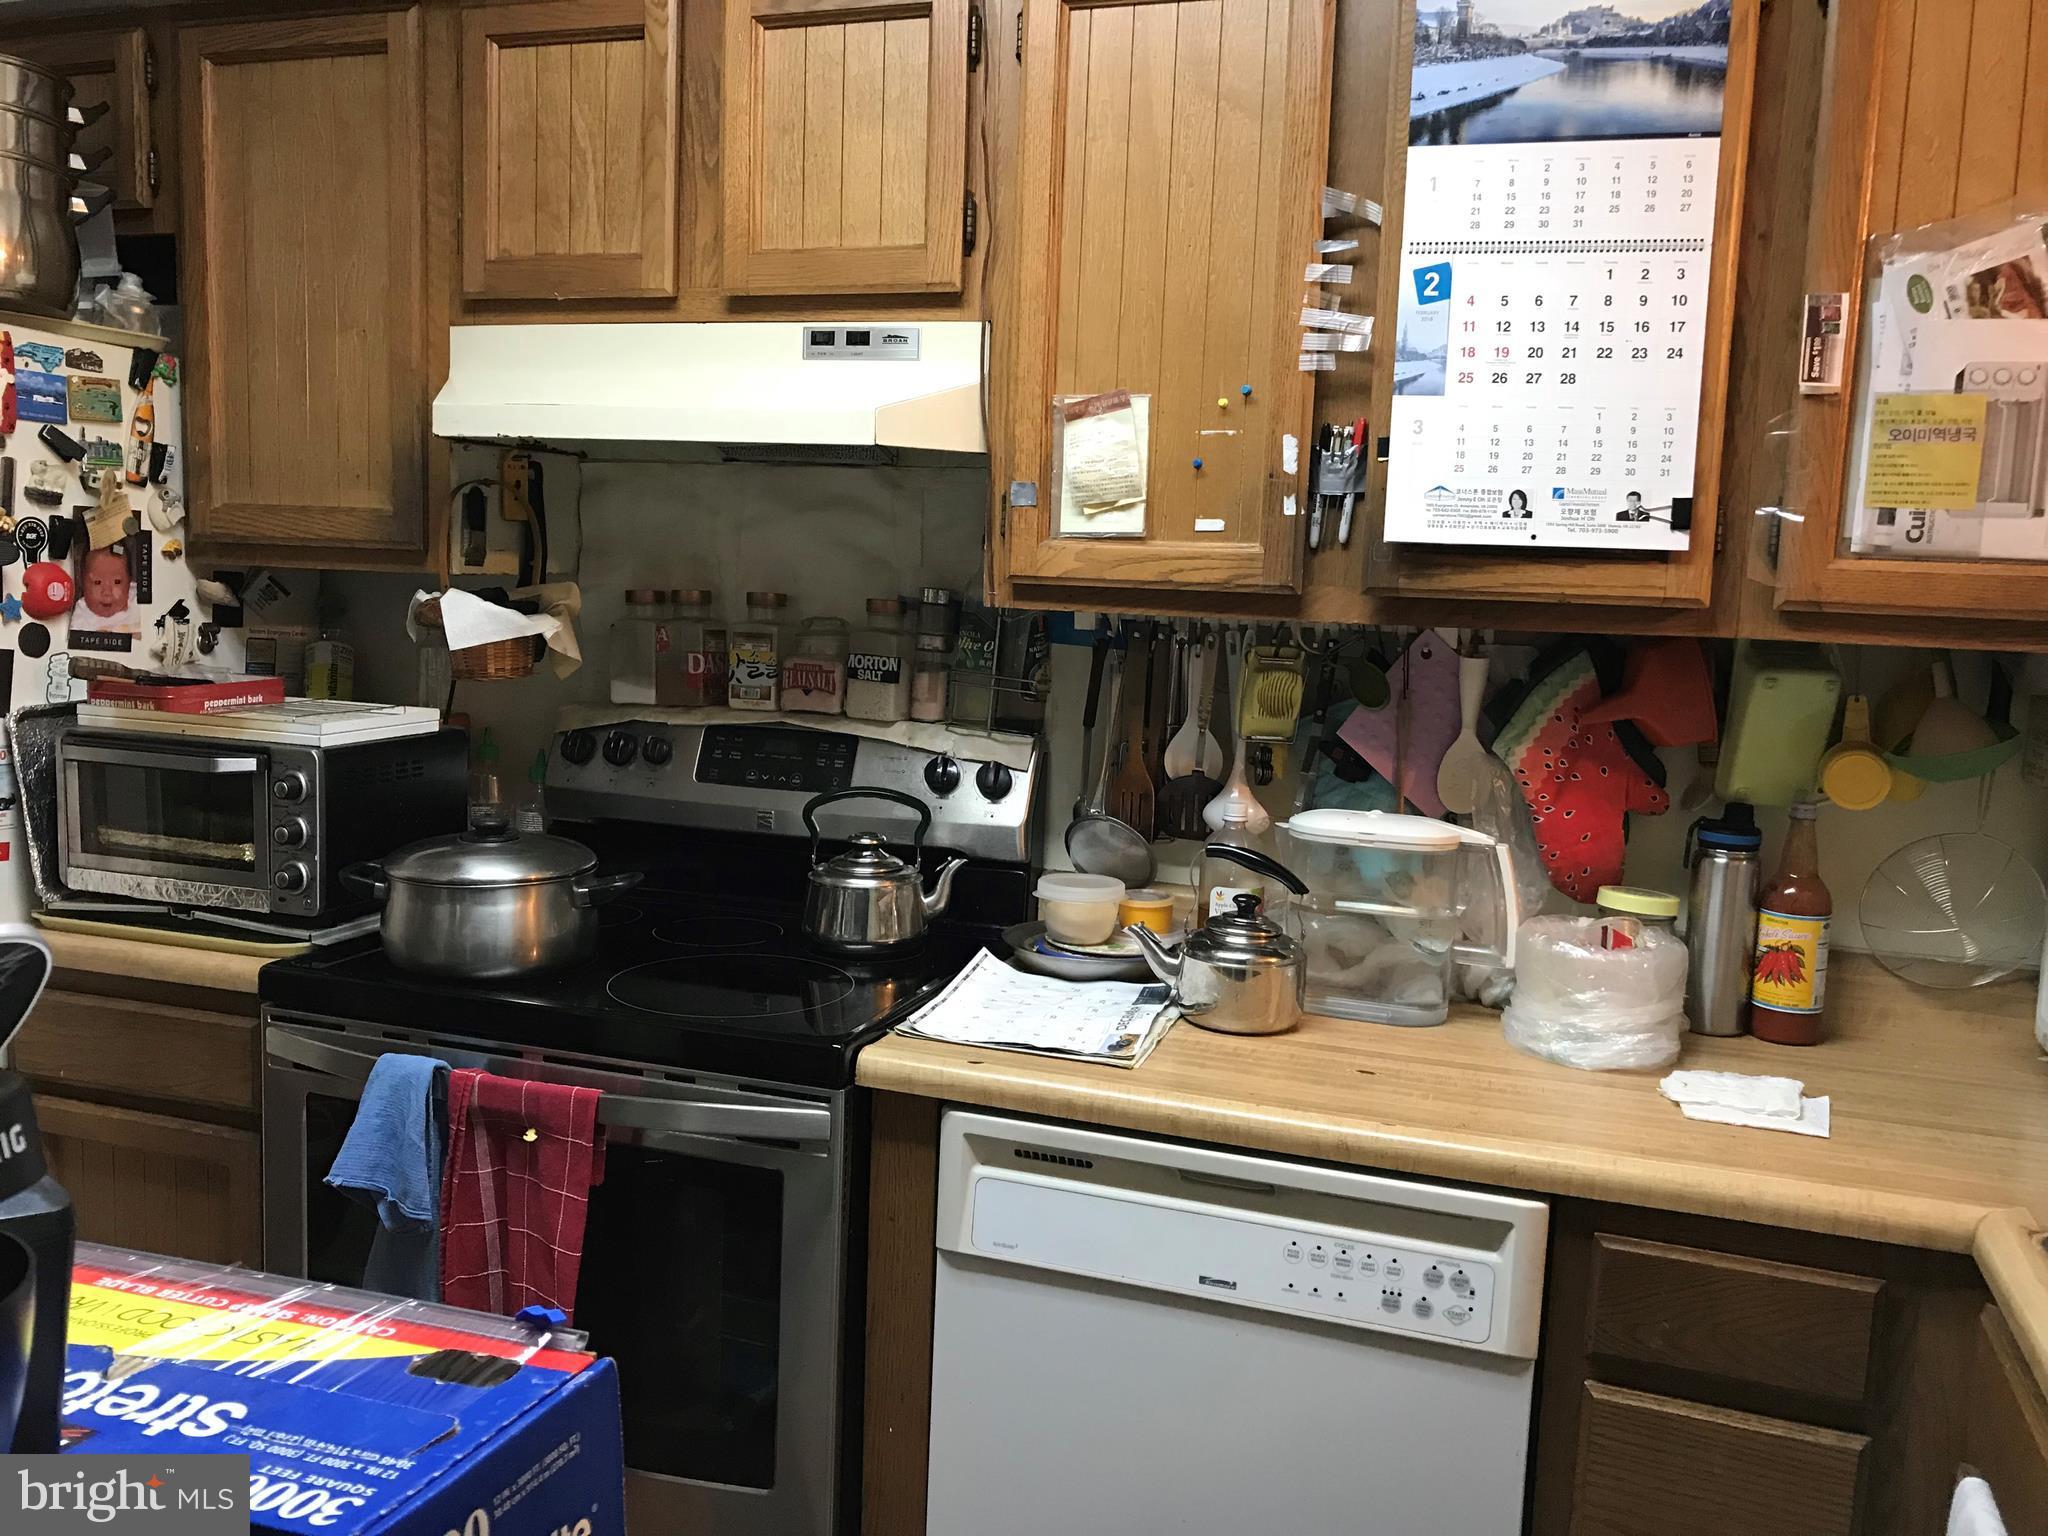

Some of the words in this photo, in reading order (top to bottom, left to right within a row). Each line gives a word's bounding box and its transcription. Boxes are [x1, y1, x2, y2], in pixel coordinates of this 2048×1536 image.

[1430, 176, 1438, 191] 1
[1474, 179, 1481, 188] 7
[1508, 178, 1515, 188] 8
[1543, 177, 1550, 187] 9
[1576, 176, 1588, 186] 10
[1611, 175, 1621, 185] 11
[1647, 175, 1659, 185] 12
[1682, 173, 1694, 184] 13
[1472, 192, 1482, 202] 14
[1506, 192, 1517, 201] 15
[1541, 191, 1552, 201] 16
[1575, 190, 1586, 200] 17
[1610, 190, 1622, 200] 18
[1646, 189, 1657, 199] 19
[1680, 188, 1693, 198] 20
[1470, 207, 1481, 216] 21
[1504, 206, 1516, 216] 22
[1538, 205, 1551, 215] 23
[1573, 205, 1585, 214] 24
[1608, 204, 1621, 214] 25
[1643, 203, 1656, 213] 26
[1679, 202, 1692, 213] 27
[1469, 220, 1481, 230] 28
[1503, 220, 1515, 229] 29
[1537, 219, 1550, 229] 30
[1572, 219, 1584, 229] 31
[1606, 268, 1613, 281] 1
[1640, 268, 1650, 281] 2
[1676, 267, 1686, 280] 3
[1423, 271, 1441, 297] 2
[1466, 295, 1475, 307] 4
[1500, 295, 1509, 307] 5
[1534, 294, 1544, 307] 6
[1569, 294, 1579, 307] 7
[1603, 294, 1613, 307] 8
[1639, 294, 1649, 307] 9
[1671, 294, 1688, 307] 10
[1462, 320, 1476, 333] 11
[1496, 320, 1512, 333] 12
[1530, 320, 1546, 333] 13
[1564, 320, 1580, 333] 14
[1599, 321, 1615, 333] 15
[1634, 320, 1650, 333] 16
[1669, 320, 1687, 333] 17
[1460, 346, 1476, 359] 18
[1494, 346, 1510, 359] 19
[1527, 346, 1544, 359] 20
[1561, 346, 1577, 359] 21
[1596, 347, 1613, 359] 22
[1631, 347, 1648, 360] 23
[1666, 347, 1684, 360] 24
[1811, 356, 1821, 378] Save
[1457, 371, 1474, 384] 25
[1491, 372, 1508, 384] 26
[1525, 372, 1543, 384] 27
[1559, 372, 1577, 385] 28
[1412, 419, 1424, 435] 3
[1458, 423, 1465, 433] 4
[1492, 424, 1499, 433] 5
[1526, 424, 1533, 434] 6
[1560, 425, 1567, 434] 7
[1595, 425, 1602, 435] 8
[1630, 426, 1637, 435] 9
[1663, 426, 1675, 436] 10
[1456, 437, 1466, 446] 11
[1489, 437, 1501, 447] 12
[1523, 438, 1535, 447] 13
[1557, 439, 1569, 448] 14
[1592, 439, 1604, 449] 15
[1627, 440, 1638, 449] 16
[1662, 440, 1674, 450] 17
[1455, 450, 1466, 460] 18
[1489, 451, 1500, 460] 19
[1522, 451, 1534, 461] 20
[1556, 452, 1567, 462] 21
[1590, 453, 1603, 462] 22
[1625, 453, 1637, 463] 23
[1660, 454, 1672, 464] 24
[1453, 464, 1465, 473] 25
[1487, 464, 1499, 474] 26
[1521, 465, 1533, 475] 27
[1555, 466, 1567, 475] 28
[1589, 466, 1602, 476] 29
[1623, 467, 1637, 477] 30
[1659, 468, 1671, 478] 31
[1566, 487, 1607, 496] MassMutual
[79, 636, 101, 645] TAPE
[104, 638, 123, 646] SIDE
[847, 653, 899, 672] MORTON
[857, 669, 883, 682] SALT
[90, 697, 134, 710] peppermint
[137, 700, 155, 711] bark
[204, 696, 246, 711] peppermint
[247, 694, 264, 704] bark
[0, 1122, 28, 1162] IG
[93, 1275, 154, 1296] BLADE
[156, 1286, 228, 1309] CUTTER
[228, 1301, 298, 1320] SRP
[300, 1313, 395, 1338] CAON:
[247, 1439, 269, 1452] SQ.
[267, 1444, 305, 1459] (3000
[302, 1452, 322, 1464] FT.
[320, 1456, 354, 1470] 3000
[257, 1464, 299, 1481] FEET
[364, 1465, 383, 1478] IN.
[381, 1469, 400, 1481] 12
[302, 1472, 378, 1497] SQUARE
